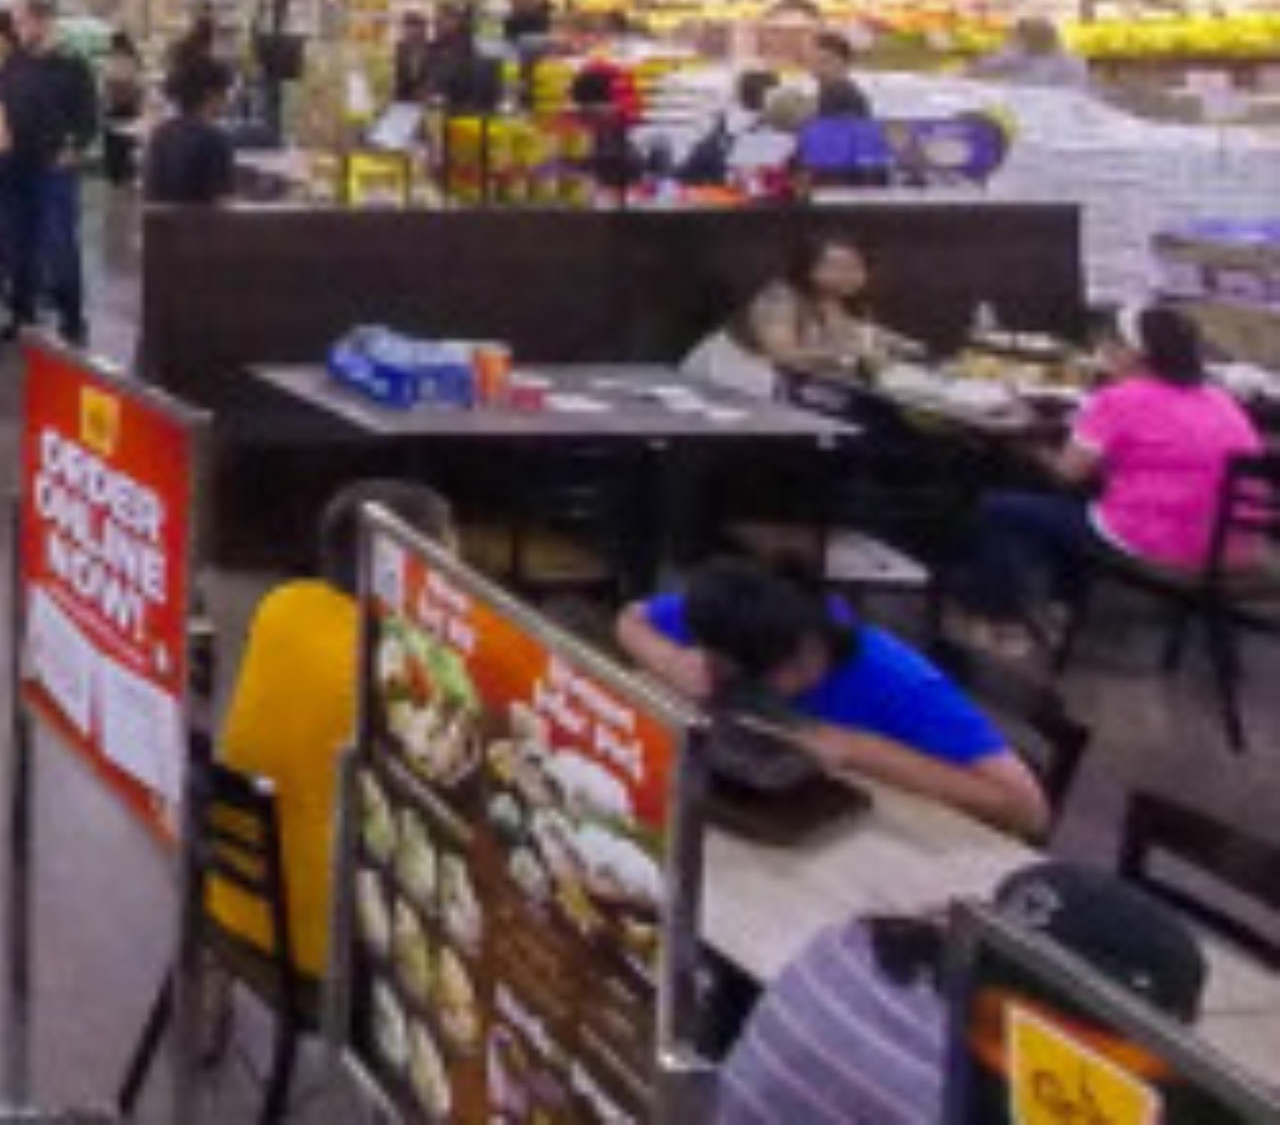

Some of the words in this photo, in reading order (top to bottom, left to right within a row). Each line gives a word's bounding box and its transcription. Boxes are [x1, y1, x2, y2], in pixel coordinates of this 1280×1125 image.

[34, 471, 169, 605] ONLINE
[40, 426, 167, 538] ORDER
[46, 526, 146, 642] NOW!
